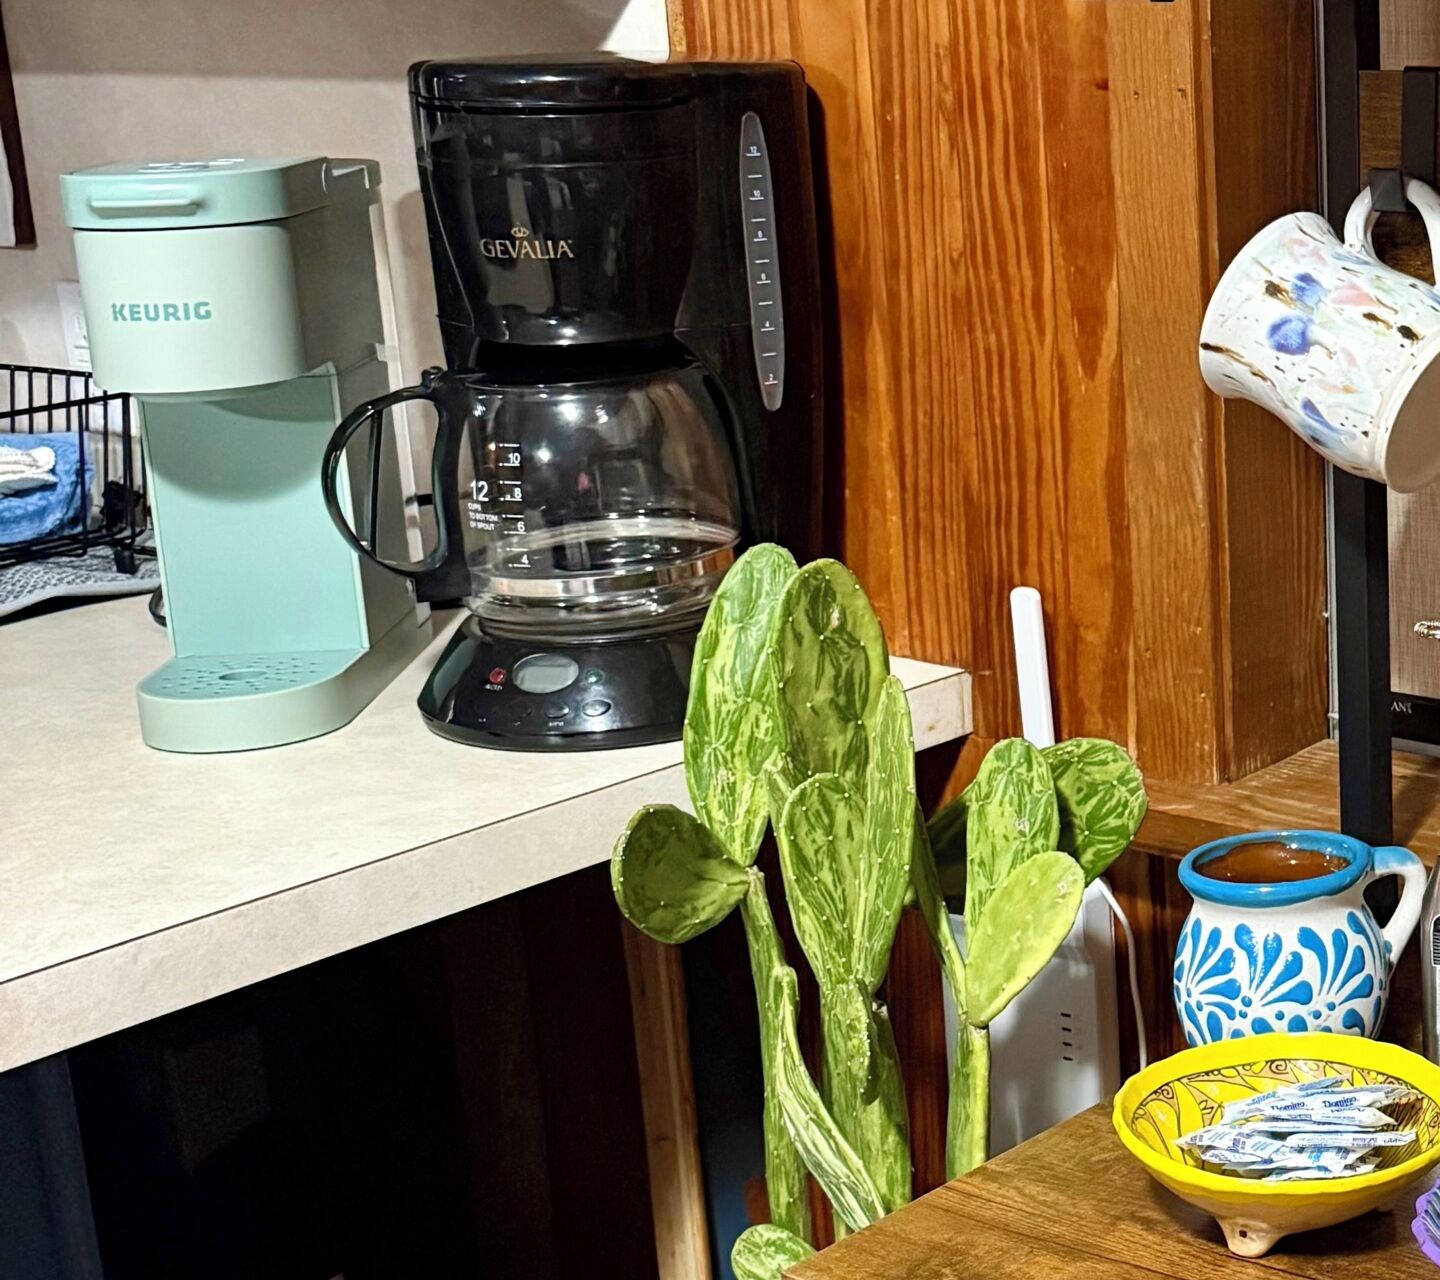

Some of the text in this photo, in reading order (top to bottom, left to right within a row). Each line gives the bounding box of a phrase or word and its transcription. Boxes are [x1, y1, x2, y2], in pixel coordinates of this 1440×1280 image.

[480, 238, 575, 259] GEVALIA
[111, 301, 212, 322] KEURIG
[508, 452, 520, 464] 10
[470, 480, 489, 501] 12
[514, 487, 522, 499] 8
[476, 512, 498, 522] BOTTOM
[477, 522, 495, 530] SPOUT
[517, 521, 526, 532] 6
[521, 554, 529, 564] 4
